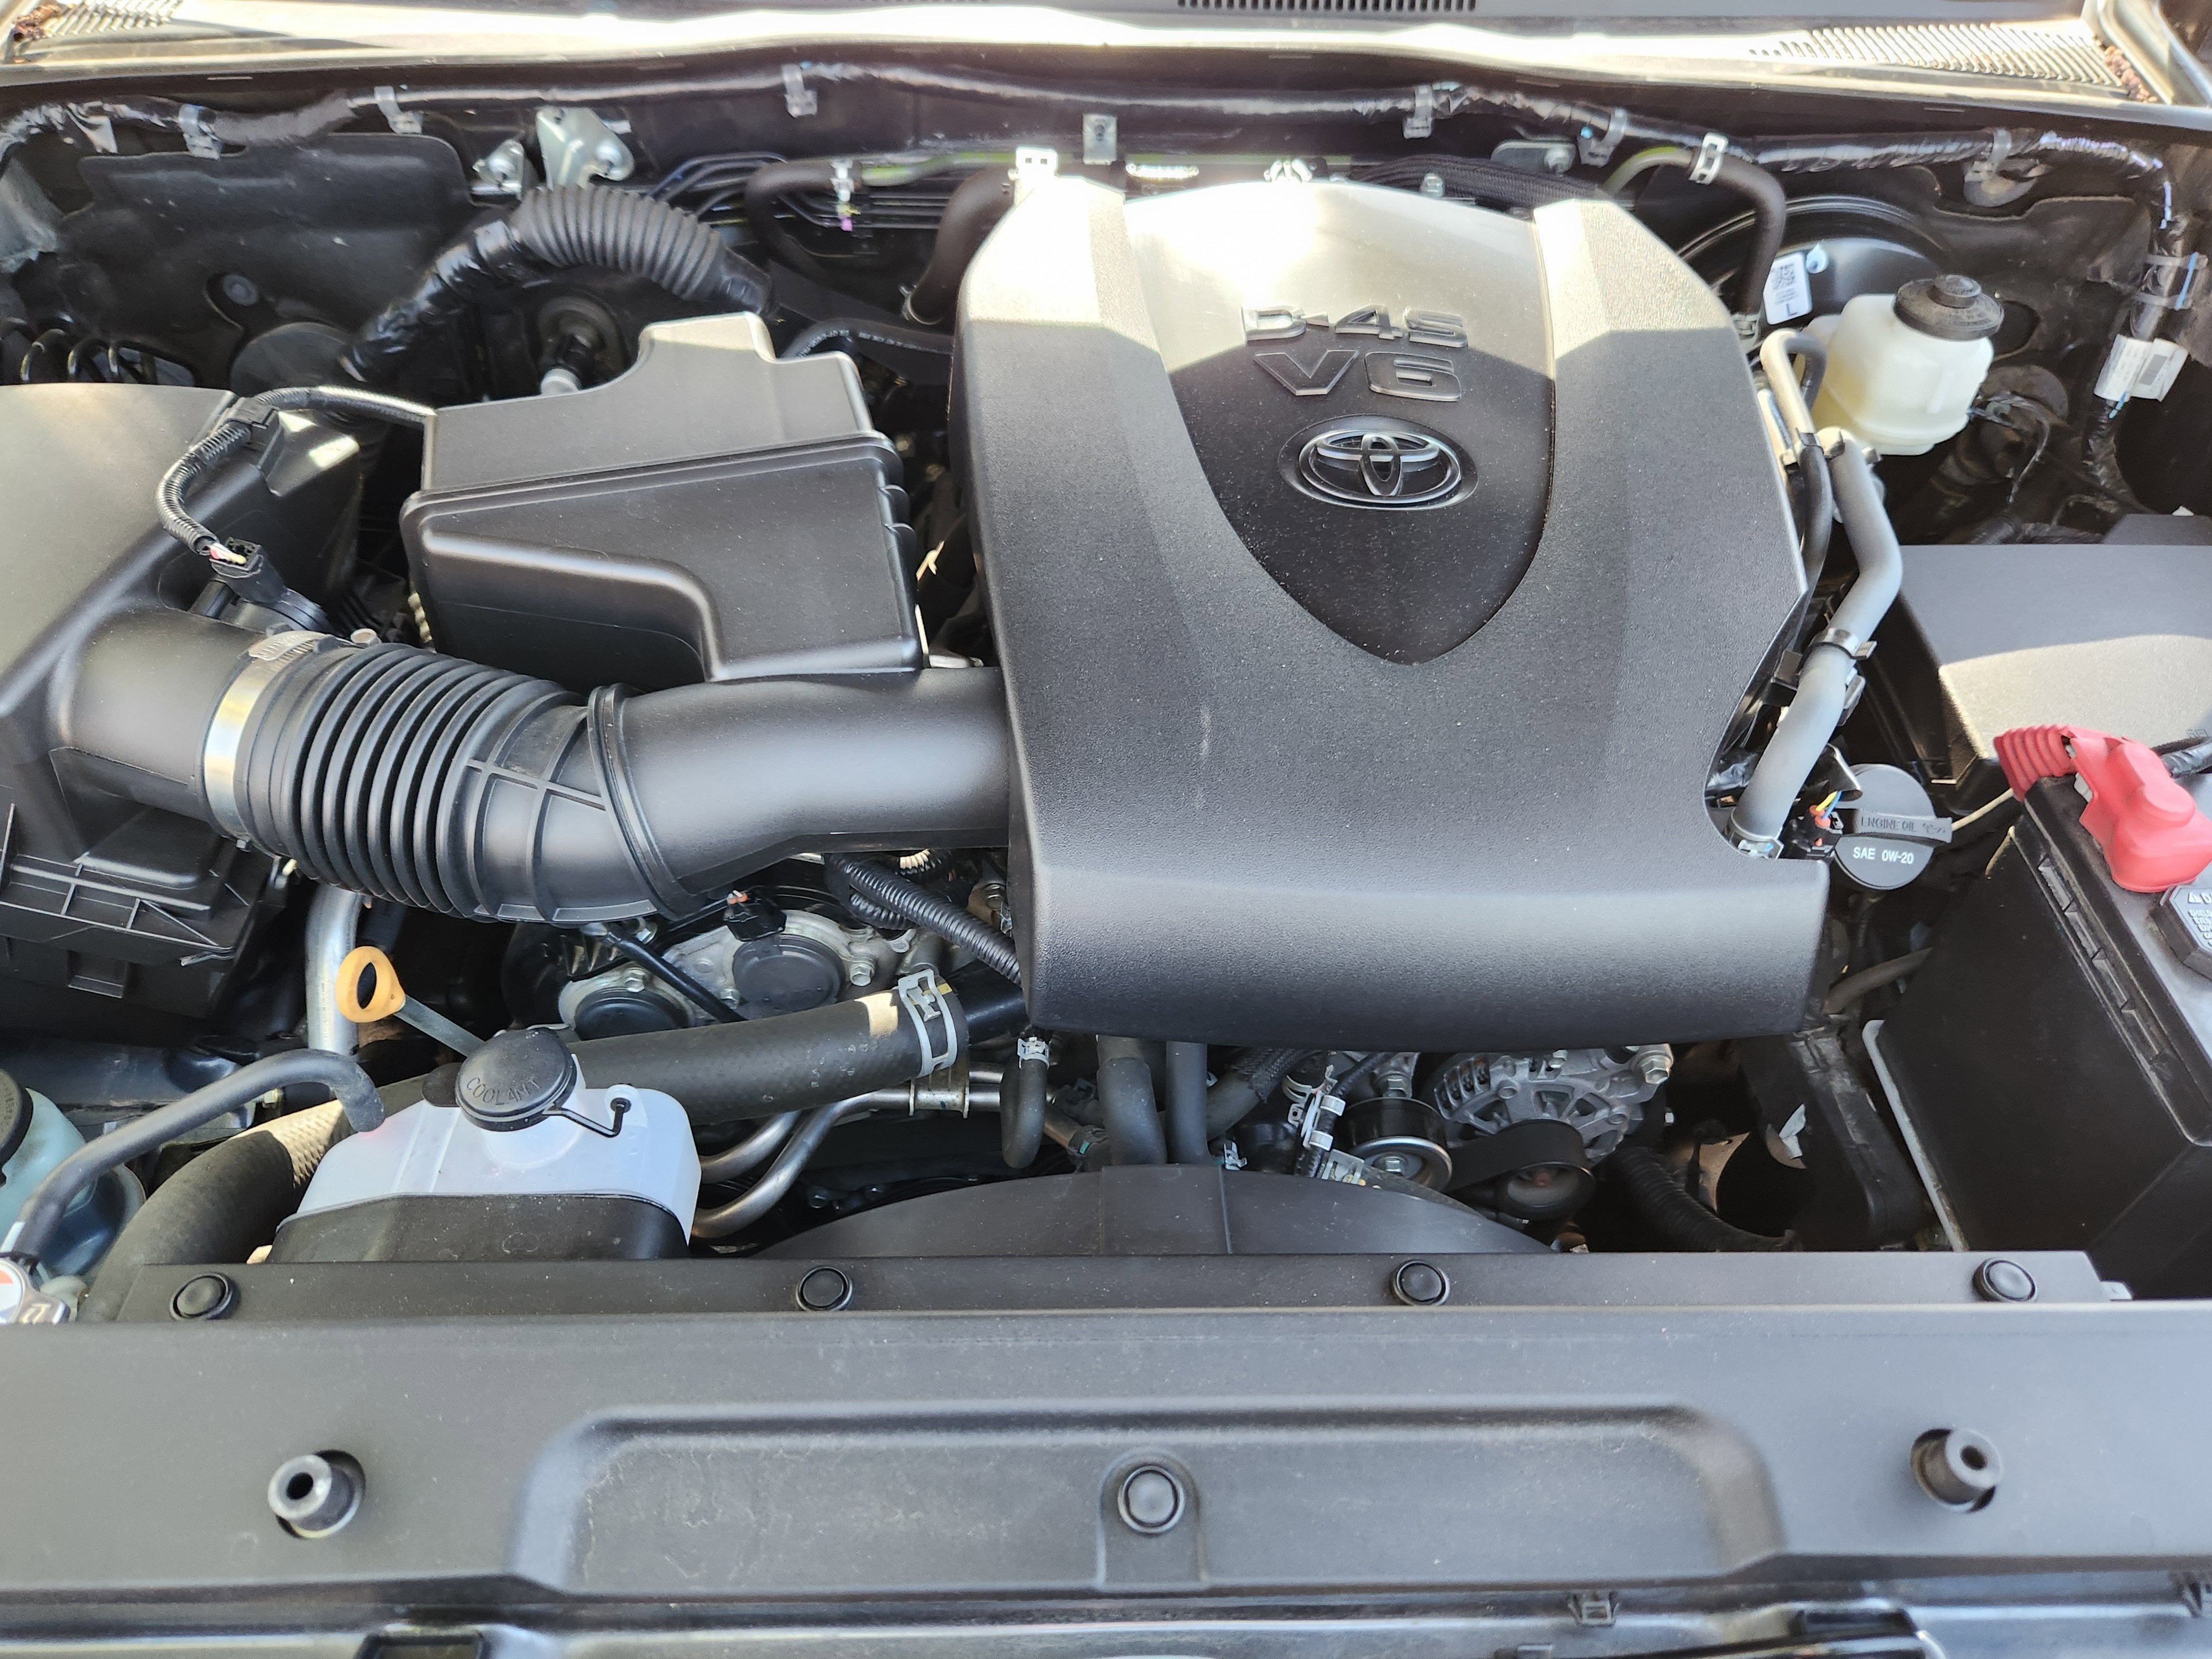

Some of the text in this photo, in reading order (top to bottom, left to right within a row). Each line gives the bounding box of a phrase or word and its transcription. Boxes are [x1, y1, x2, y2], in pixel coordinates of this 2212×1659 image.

[1241, 303, 1468, 348] D-4S
[1253, 349, 1462, 402] V6
[1861, 816, 1919, 832] ENGINE OIL
[1853, 846, 1914, 864] SAE 0W-20
[467, 1076, 542, 1105] COOLANT
